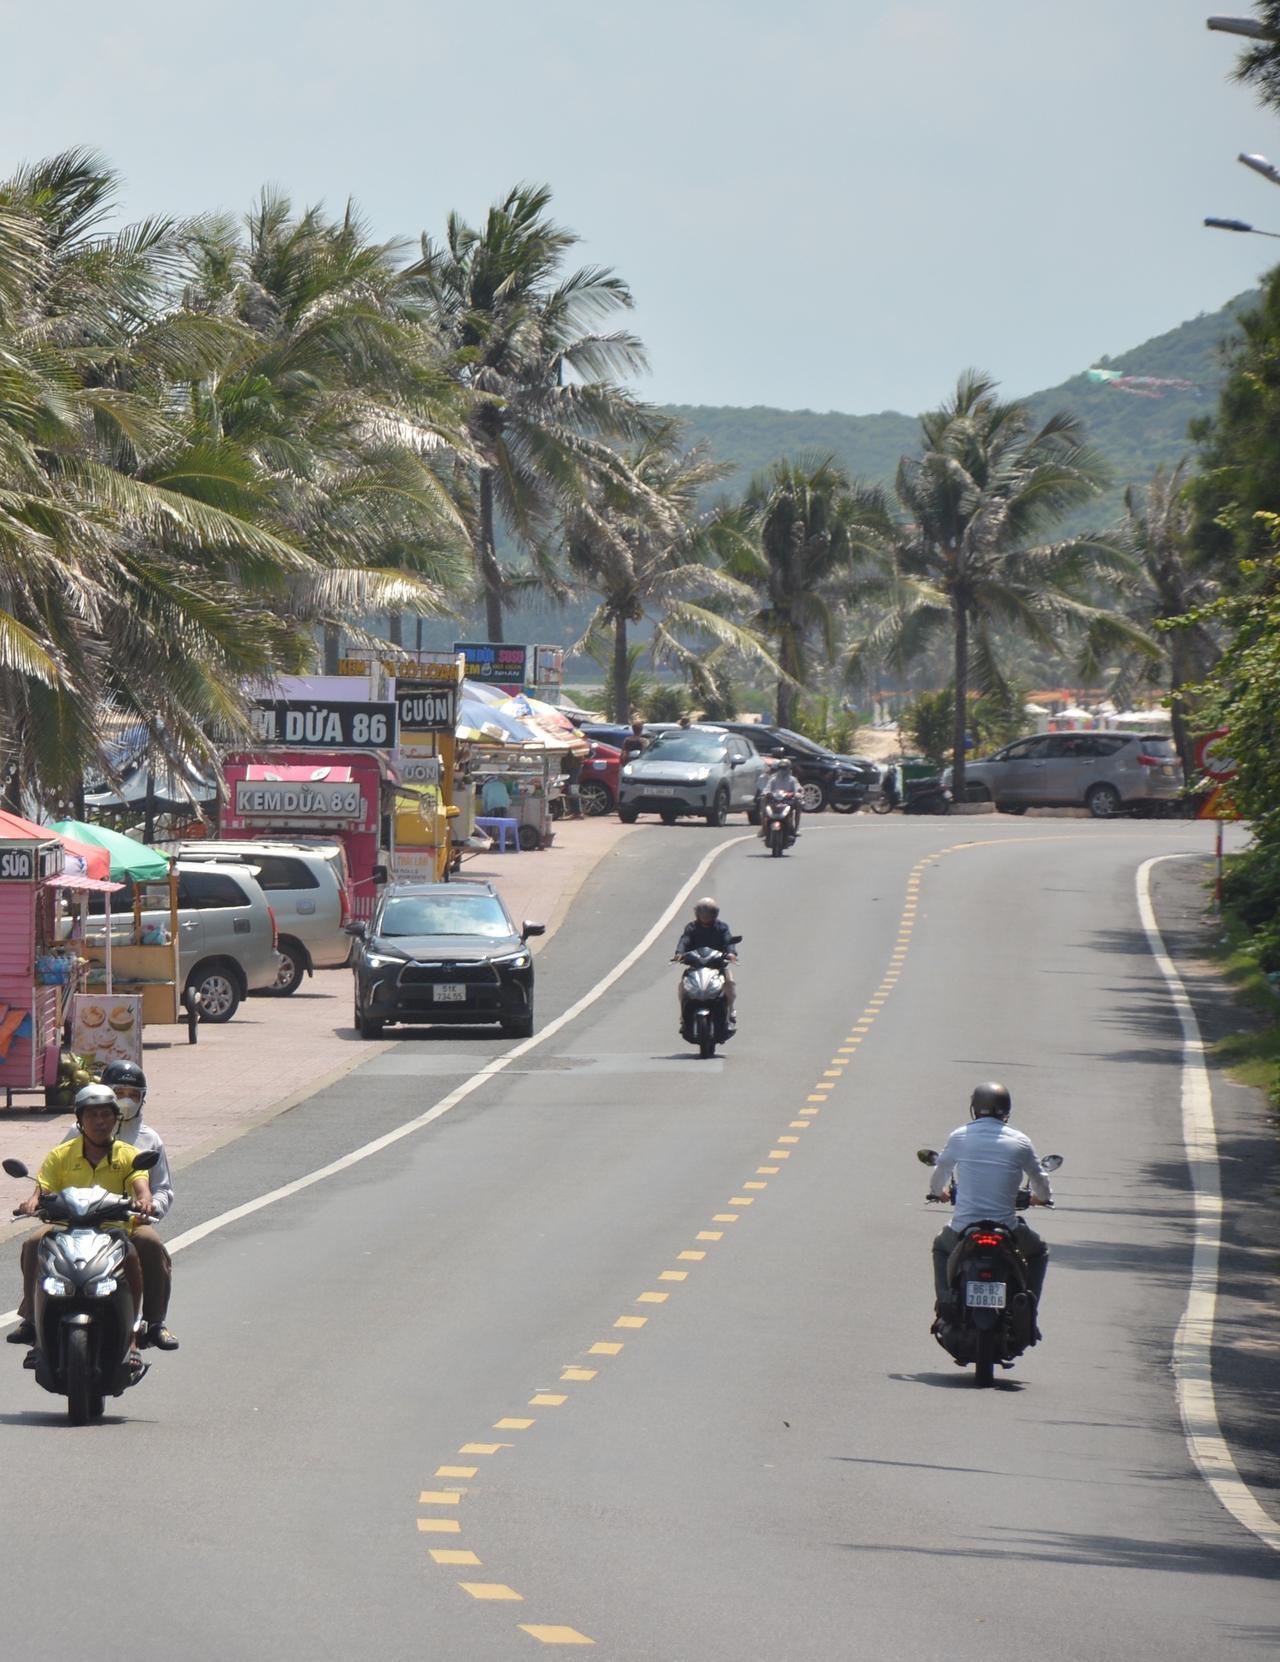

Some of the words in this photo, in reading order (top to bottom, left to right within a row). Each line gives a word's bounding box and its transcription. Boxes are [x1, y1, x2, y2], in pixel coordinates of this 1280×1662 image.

[286, 704, 344, 743] DỪA
[352, 712, 388, 744] 86
[238, 791, 282, 812] KEM
[284, 784, 328, 813] DỪA
[330, 792, 356, 813] 86
